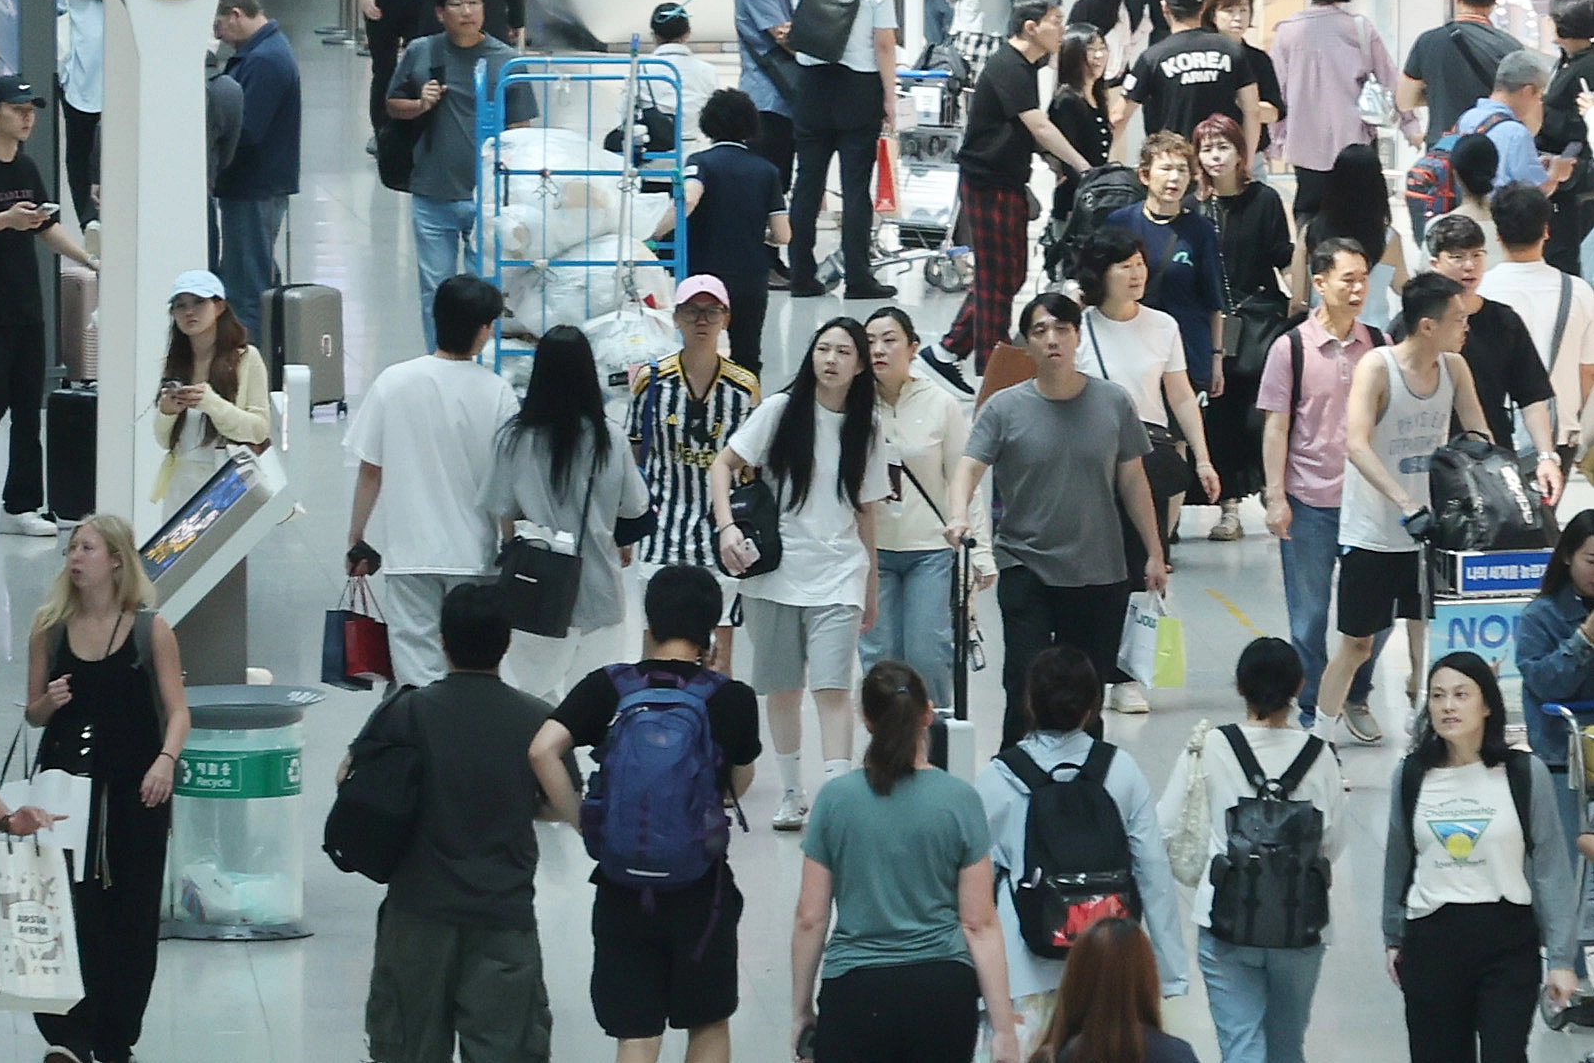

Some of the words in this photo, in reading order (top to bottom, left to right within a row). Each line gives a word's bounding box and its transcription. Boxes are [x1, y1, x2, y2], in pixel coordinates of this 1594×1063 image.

[1160, 51, 1232, 79] KOREA
[1180, 70, 1219, 85] ARMY
[196, 777, 233, 789] Recycle
